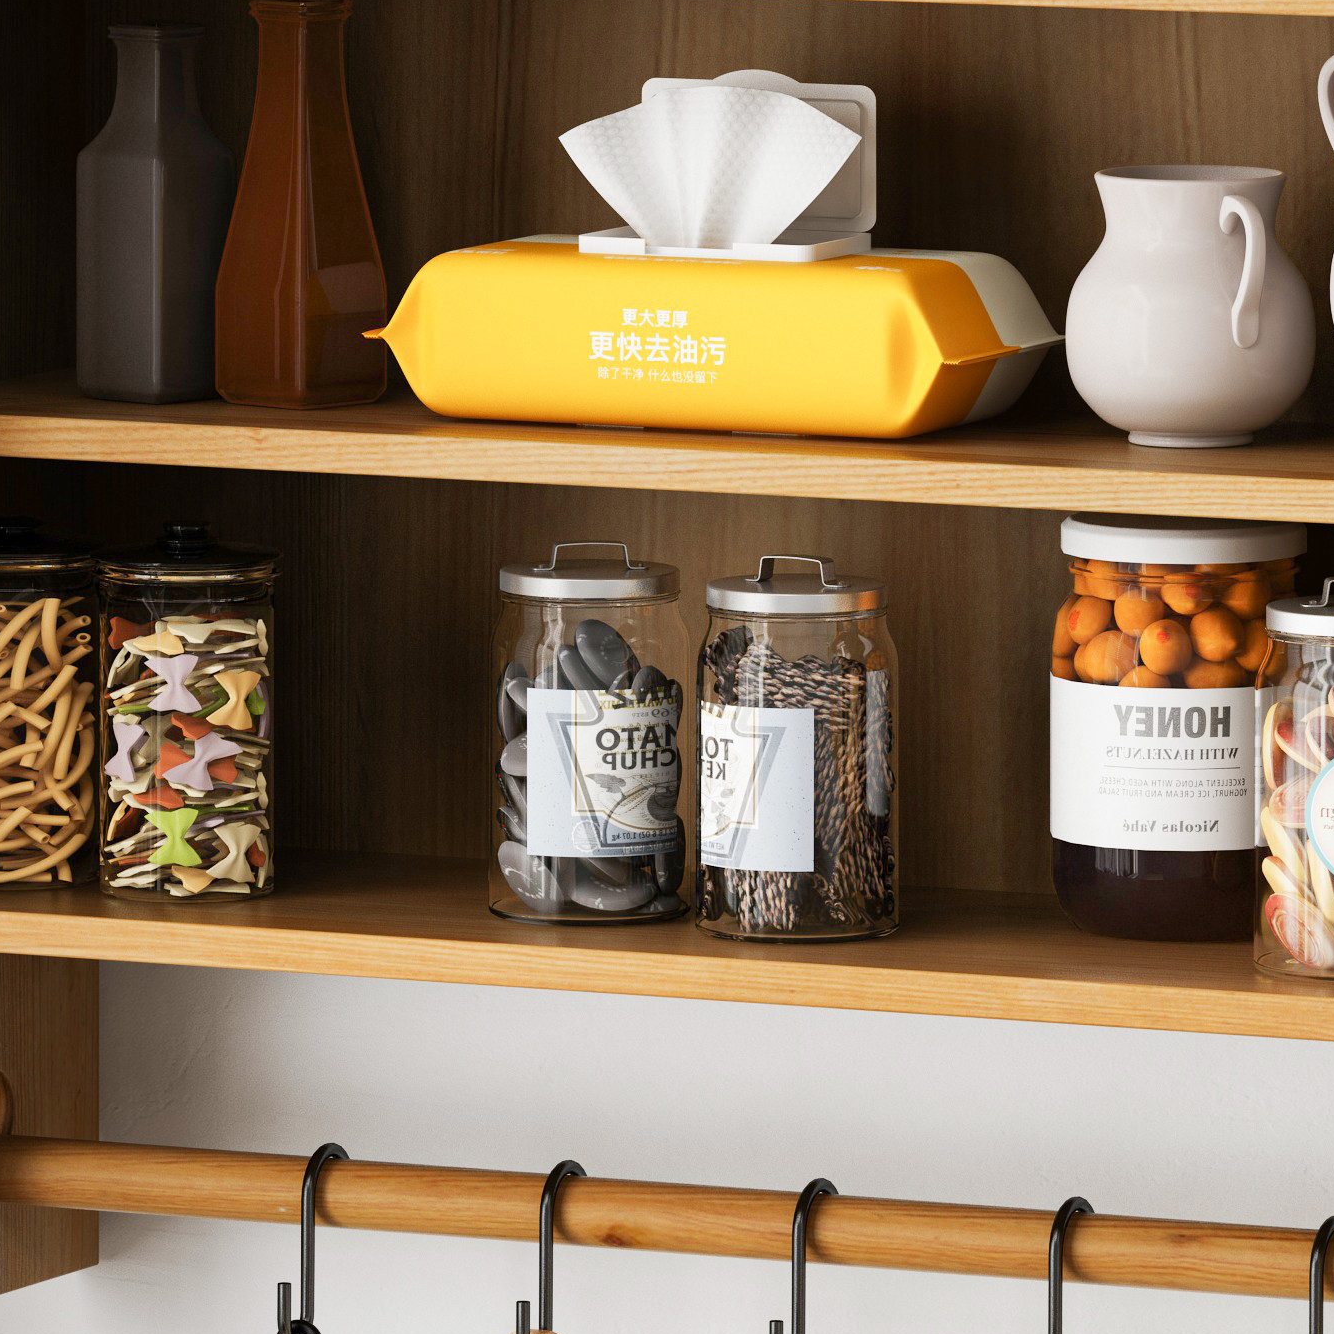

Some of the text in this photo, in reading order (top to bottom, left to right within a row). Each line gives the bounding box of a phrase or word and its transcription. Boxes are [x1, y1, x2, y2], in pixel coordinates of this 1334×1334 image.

[621, 308, 688, 328] 更大更厚
[588, 331, 726, 366] 更快去油污
[597, 367, 644, 380] 除了干净
